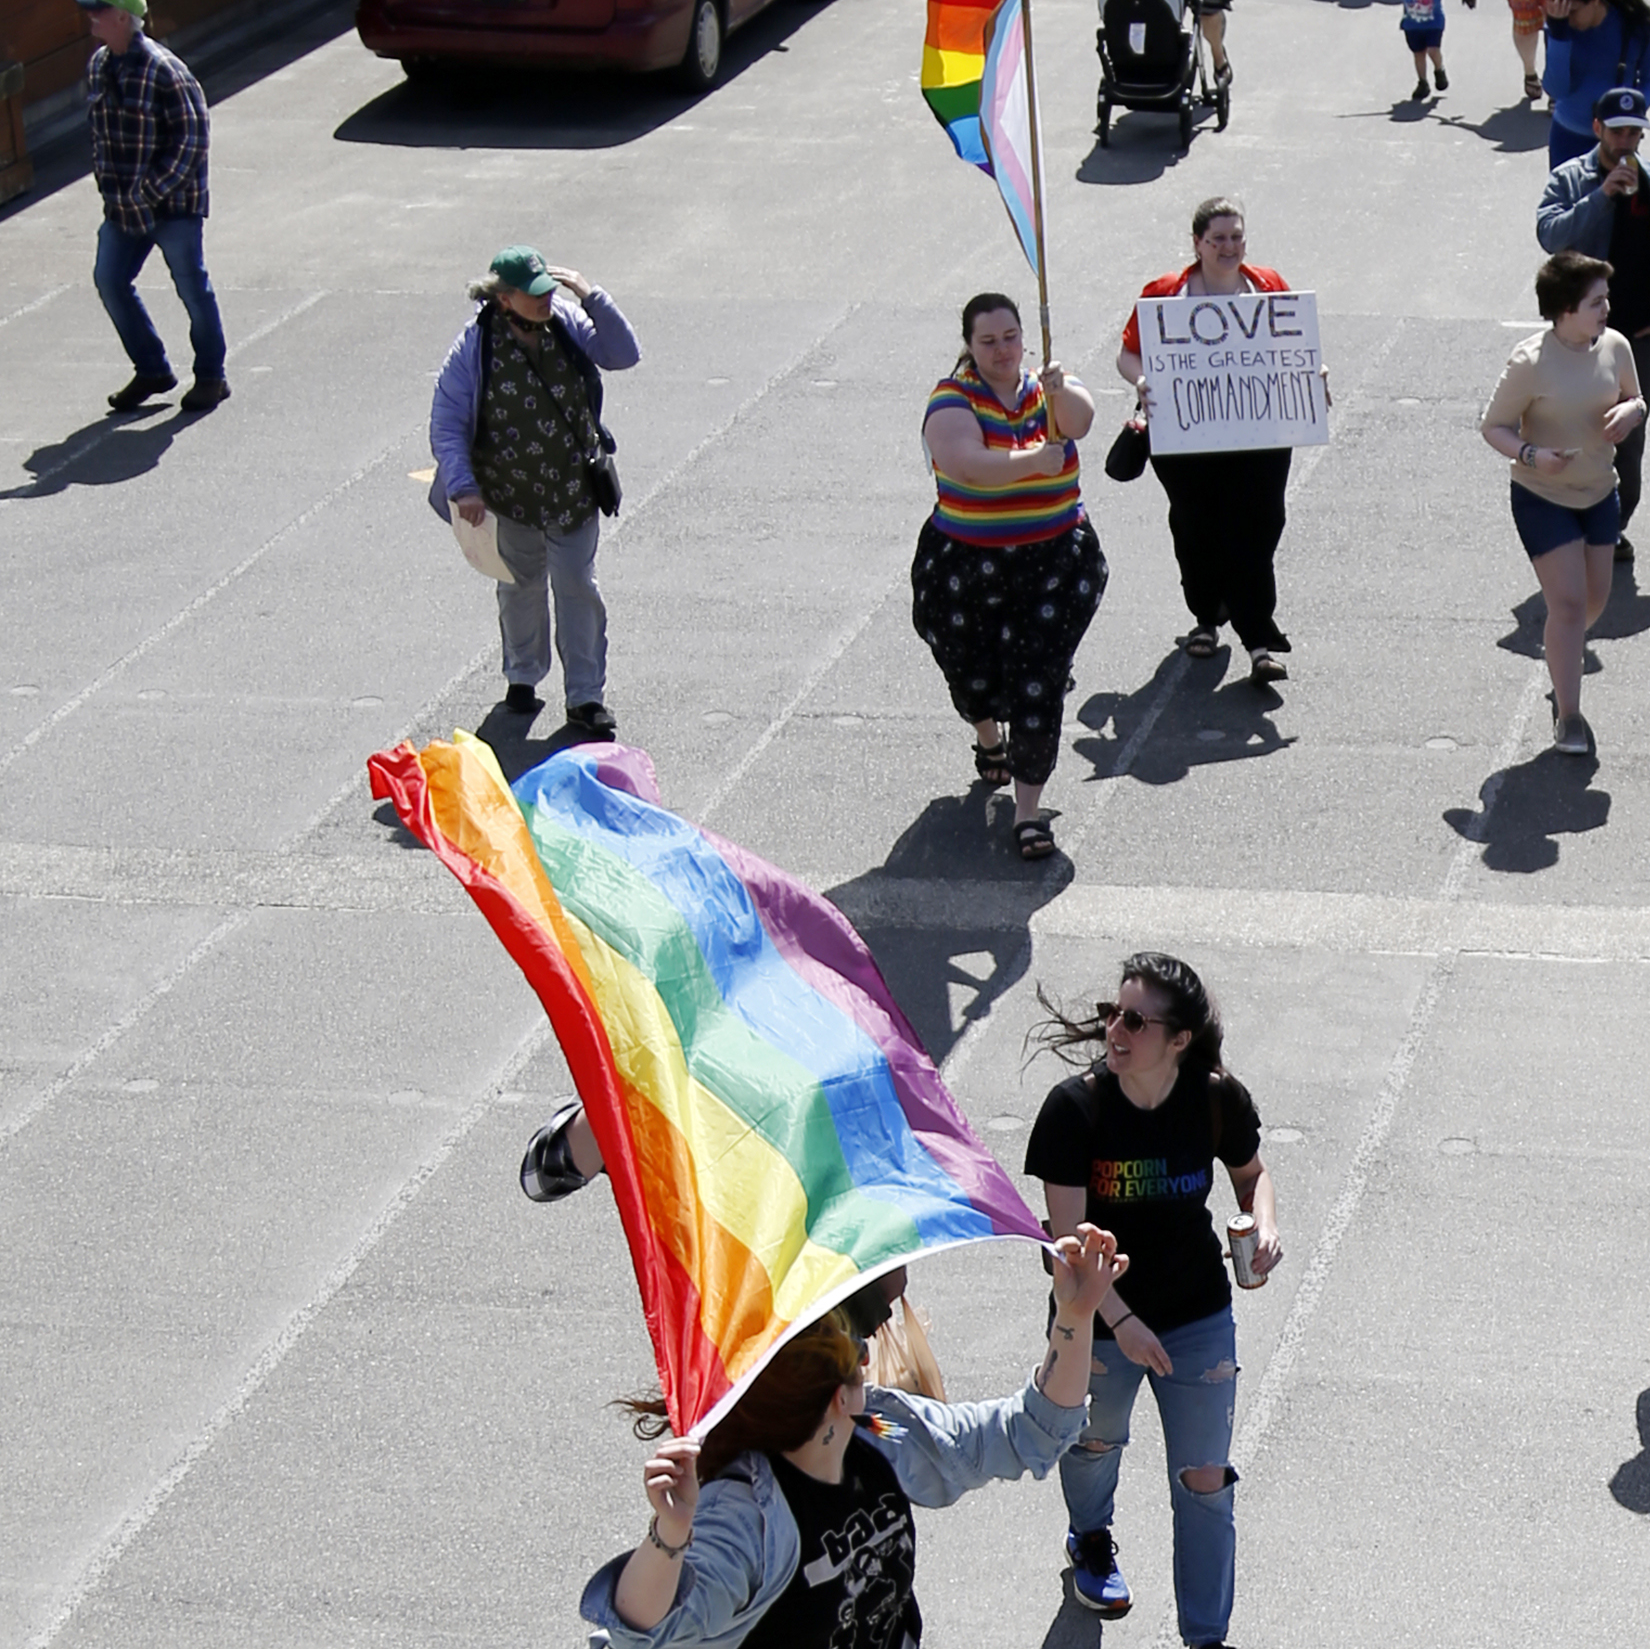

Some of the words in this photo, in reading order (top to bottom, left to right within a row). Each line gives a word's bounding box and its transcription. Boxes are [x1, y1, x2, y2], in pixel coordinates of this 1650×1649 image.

[1156, 295, 1303, 346] LOVE
[1149, 355, 1166, 372] IS
[1167, 352, 1198, 371] THE
[1208, 349, 1318, 368] GREATEST
[1172, 370, 1316, 432] COMMANDMENT
[1089, 1175, 1121, 1198] FOR
[1124, 1168, 1208, 1198] EVERYONE
[1092, 1158, 1168, 1180] POPCORN
